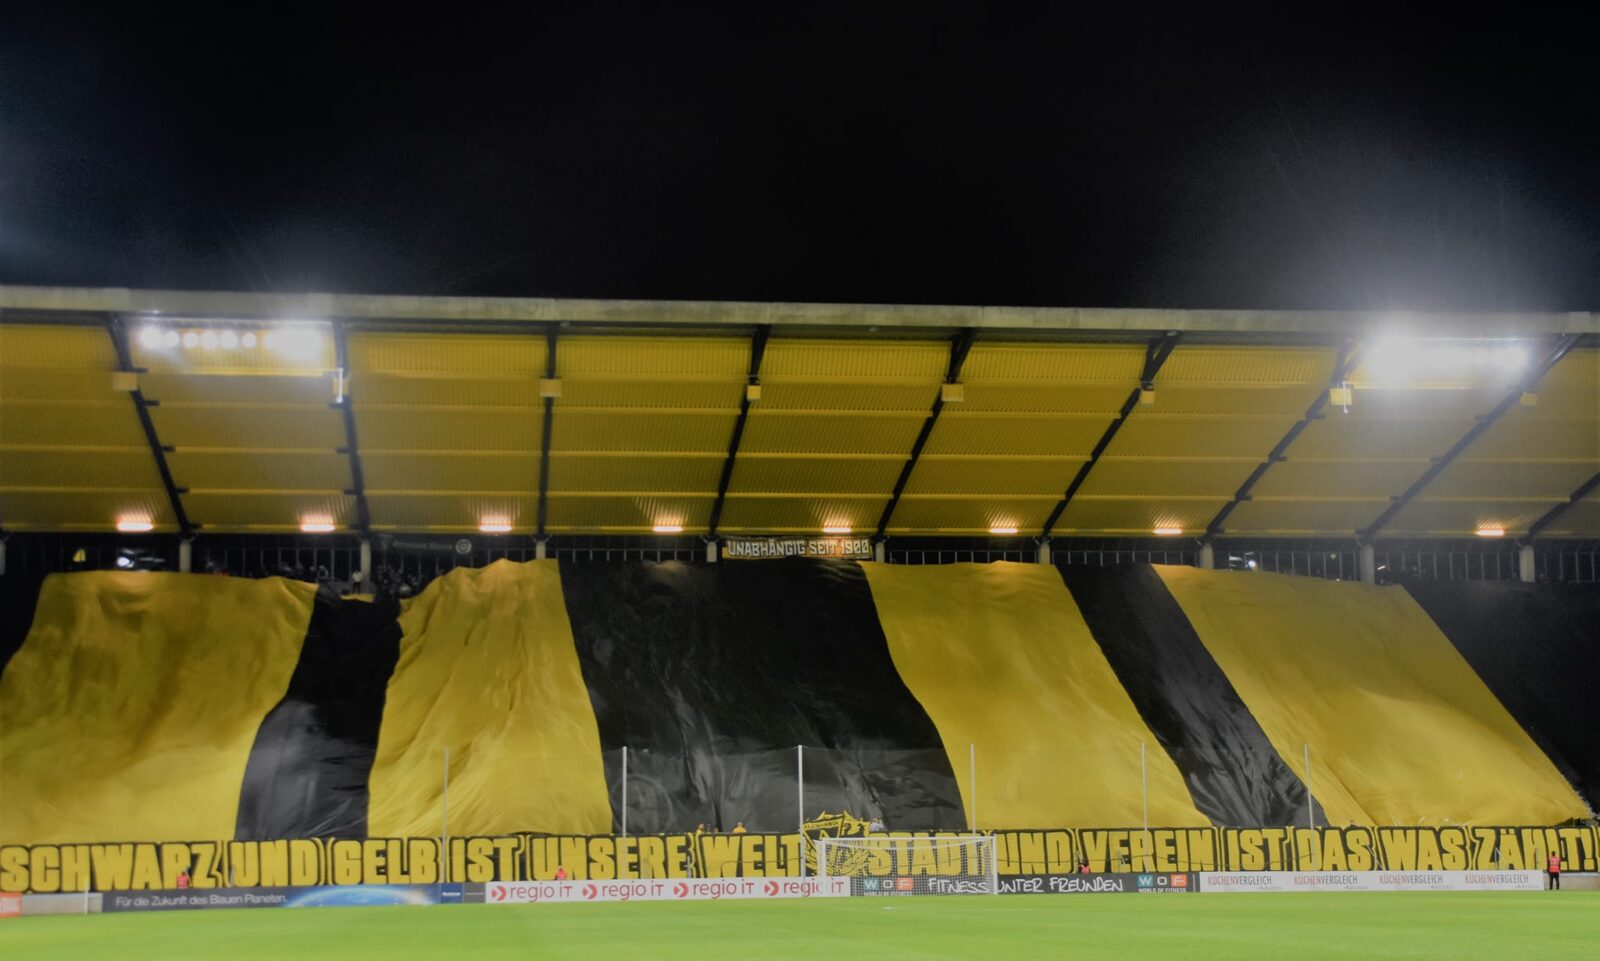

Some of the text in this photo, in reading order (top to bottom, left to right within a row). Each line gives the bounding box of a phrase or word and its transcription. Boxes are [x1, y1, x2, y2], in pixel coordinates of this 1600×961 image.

[728, 539, 869, 556] UNABHÄNGIG SEIT 1900
[0, 828, 1595, 892] SCHWARZ UND GELB IST UNSERE WELT STADT UND VEREIN IST DAS WAS ZÄHLT!
[928, 878, 989, 893] FITNESS
[1050, 877, 1123, 893] FREUNDEN
[1208, 875, 1272, 885] KÜCHENVERGLEICH
[1294, 874, 1358, 884] KÜCHENVERGLEICH
[1379, 874, 1443, 884] KÜCHENVERGLEICH
[1464, 874, 1529, 884] KÜCHENVERGLEICH
[510, 884, 556, 902] regio
[602, 882, 646, 900] regio
[693, 880, 737, 899] regio
[116, 896, 132, 907] Für
[134, 896, 149, 906] die
[151, 895, 188, 906] Zukunft
[189, 895, 208, 905] des
[210, 894, 243, 904] Blauen
